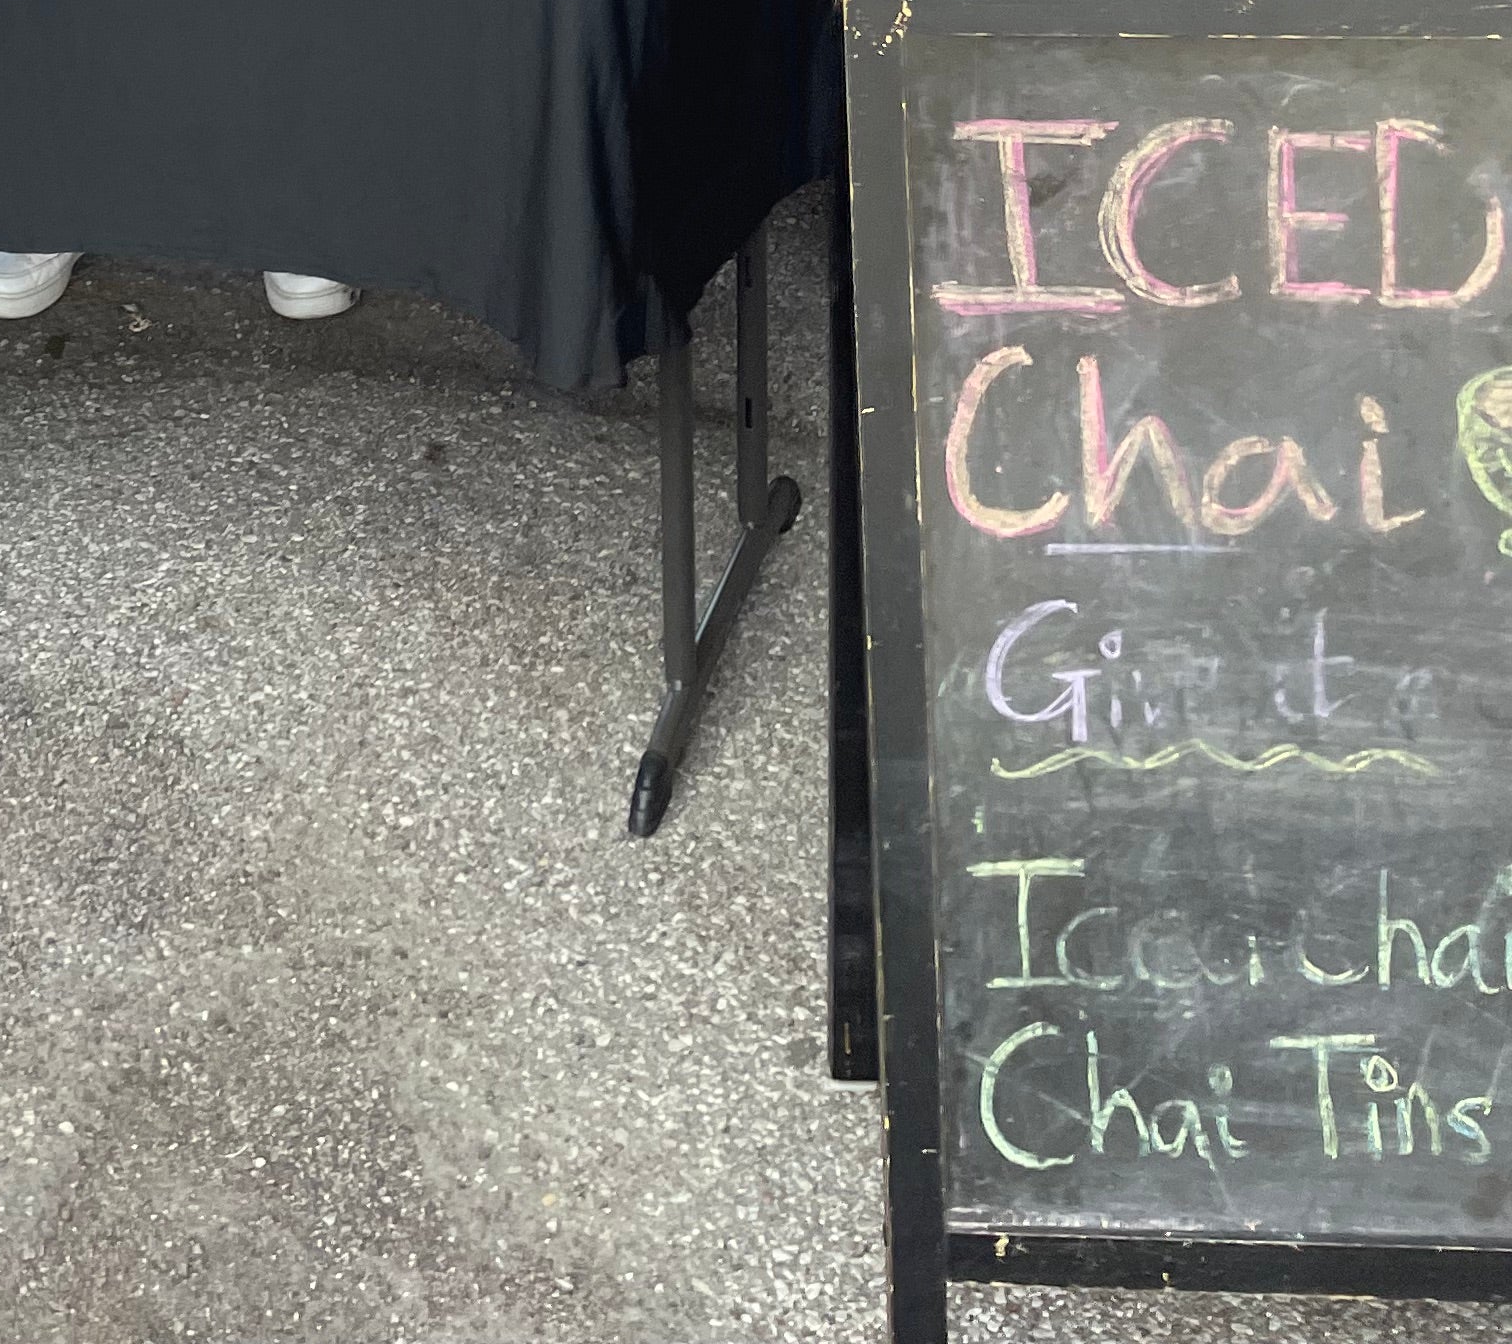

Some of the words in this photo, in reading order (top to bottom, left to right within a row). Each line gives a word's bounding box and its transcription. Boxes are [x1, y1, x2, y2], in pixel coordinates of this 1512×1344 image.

[931, 117, 1506, 317] ICED
[945, 344, 1426, 538] Chai
[979, 1020, 1250, 1172] Chai
[1268, 1032, 1494, 1164] Tins
